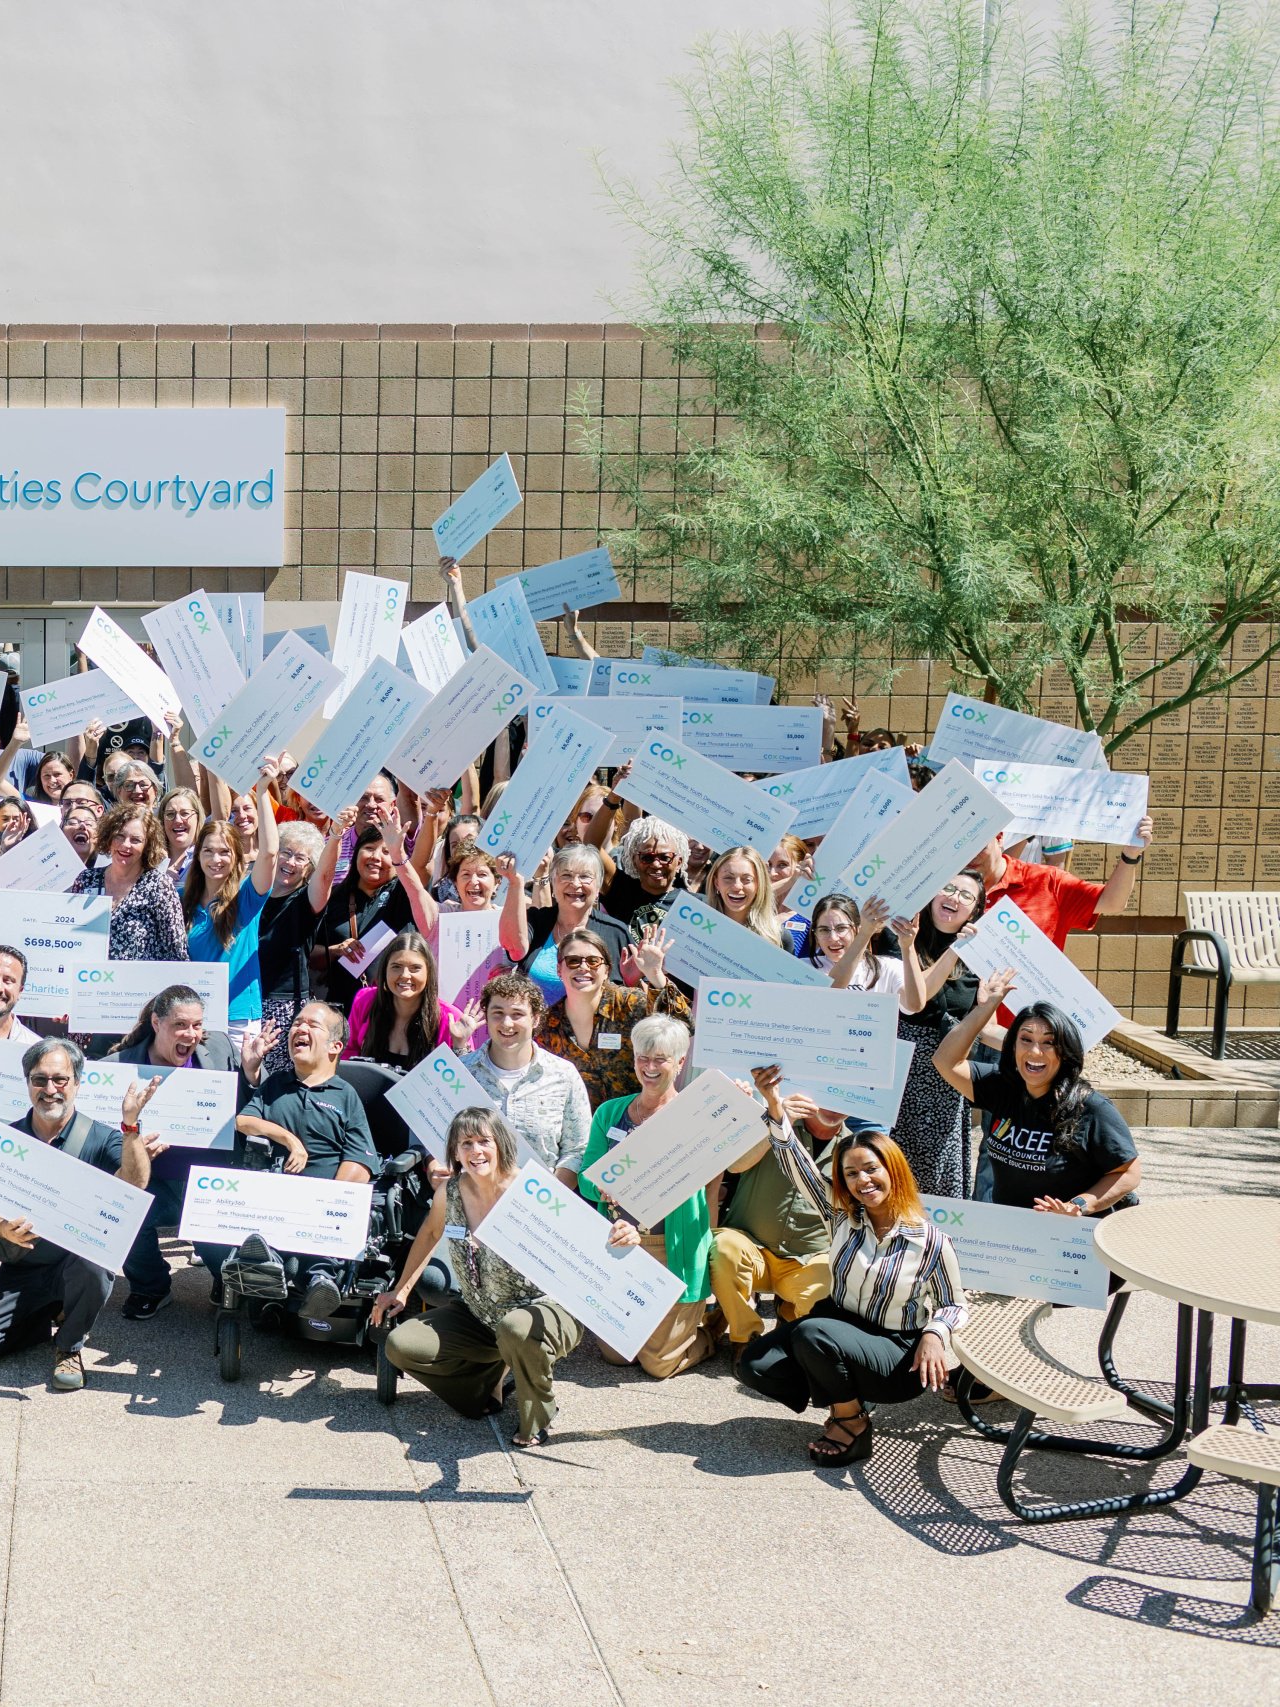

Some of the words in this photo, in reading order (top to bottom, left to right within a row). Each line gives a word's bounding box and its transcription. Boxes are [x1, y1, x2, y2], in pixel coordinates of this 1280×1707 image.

[73, 469, 274, 512] Courtyard
[188, 600, 211, 635] COX
[617, 672, 651, 685] COX
[27, 689, 57, 706] COX
[491, 683, 522, 717] COX
[244, 726, 253, 735] for
[251, 708, 268, 727] Children
[951, 704, 989, 724] COX
[203, 723, 233, 757] COX
[333, 751, 348, 770] Partners
[349, 731, 362, 747] Health
[361, 714, 374, 729] Aging
[649, 742, 687, 770] COX
[300, 753, 328, 788] COX
[982, 769, 1022, 784] COX
[519, 812, 527, 822] Art
[524, 786, 542, 813] Association
[656, 769, 671, 780] Larry
[670, 776, 689, 789] Thomas
[688, 786, 703, 797] Youth
[702, 794, 735, 816] Development
[486, 809, 513, 846] COX
[745, 818, 765, 833] $5,000
[853, 852, 886, 886] COX
[900, 852, 914, 866] Clubs
[679, 905, 718, 935] COX
[997, 910, 1031, 946] COX
[77, 970, 114, 982] COX
[1003, 934, 1018, 950] Arizona
[1024, 958, 1045, 980] University
[1043, 976, 1065, 999] Foundation
[23, 981, 69, 995] Charities
[707, 990, 752, 1008] COX
[791, 1024, 815, 1032] Services
[848, 1028, 871, 1037] $5,000
[1070, 1011, 1087, 1028] $5,000
[816, 1055, 834, 1064] COX
[836, 1056, 868, 1067] Charities
[433, 1058, 466, 1096] COX
[1002, 1126, 1053, 1152] ACEE
[600, 1152, 638, 1183] COX
[632, 1169, 650, 1183] Arizona
[648, 1154, 670, 1171] Helping
[666, 1142, 684, 1156] Hands
[1009, 1160, 1046, 1172] EDUCATION
[1012, 1150, 1046, 1161] COUNCIL
[13, 1169, 31, 1181] Puede
[30, 1177, 61, 1195] Foundation
[197, 1176, 239, 1192] COX
[216, 1198, 245, 1206] Ability360
[524, 1177, 567, 1217] COX
[99, 1209, 120, 1223] $6,000
[326, 1209, 347, 1217] $5,000
[528, 1212, 552, 1233] Helping
[550, 1229, 570, 1246] Hands
[568, 1243, 579, 1254] for
[576, 1250, 596, 1269] Single
[594, 1264, 612, 1281] Moms
[959, 1237, 978, 1245] Council
[986, 1240, 1009, 1249] Economic
[1011, 1244, 1036, 1253] Education
[1061, 1251, 1086, 1260] $5,000
[625, 1288, 646, 1307] $7,500
[584, 1293, 602, 1310] COX
[599, 1306, 627, 1331] Charities
